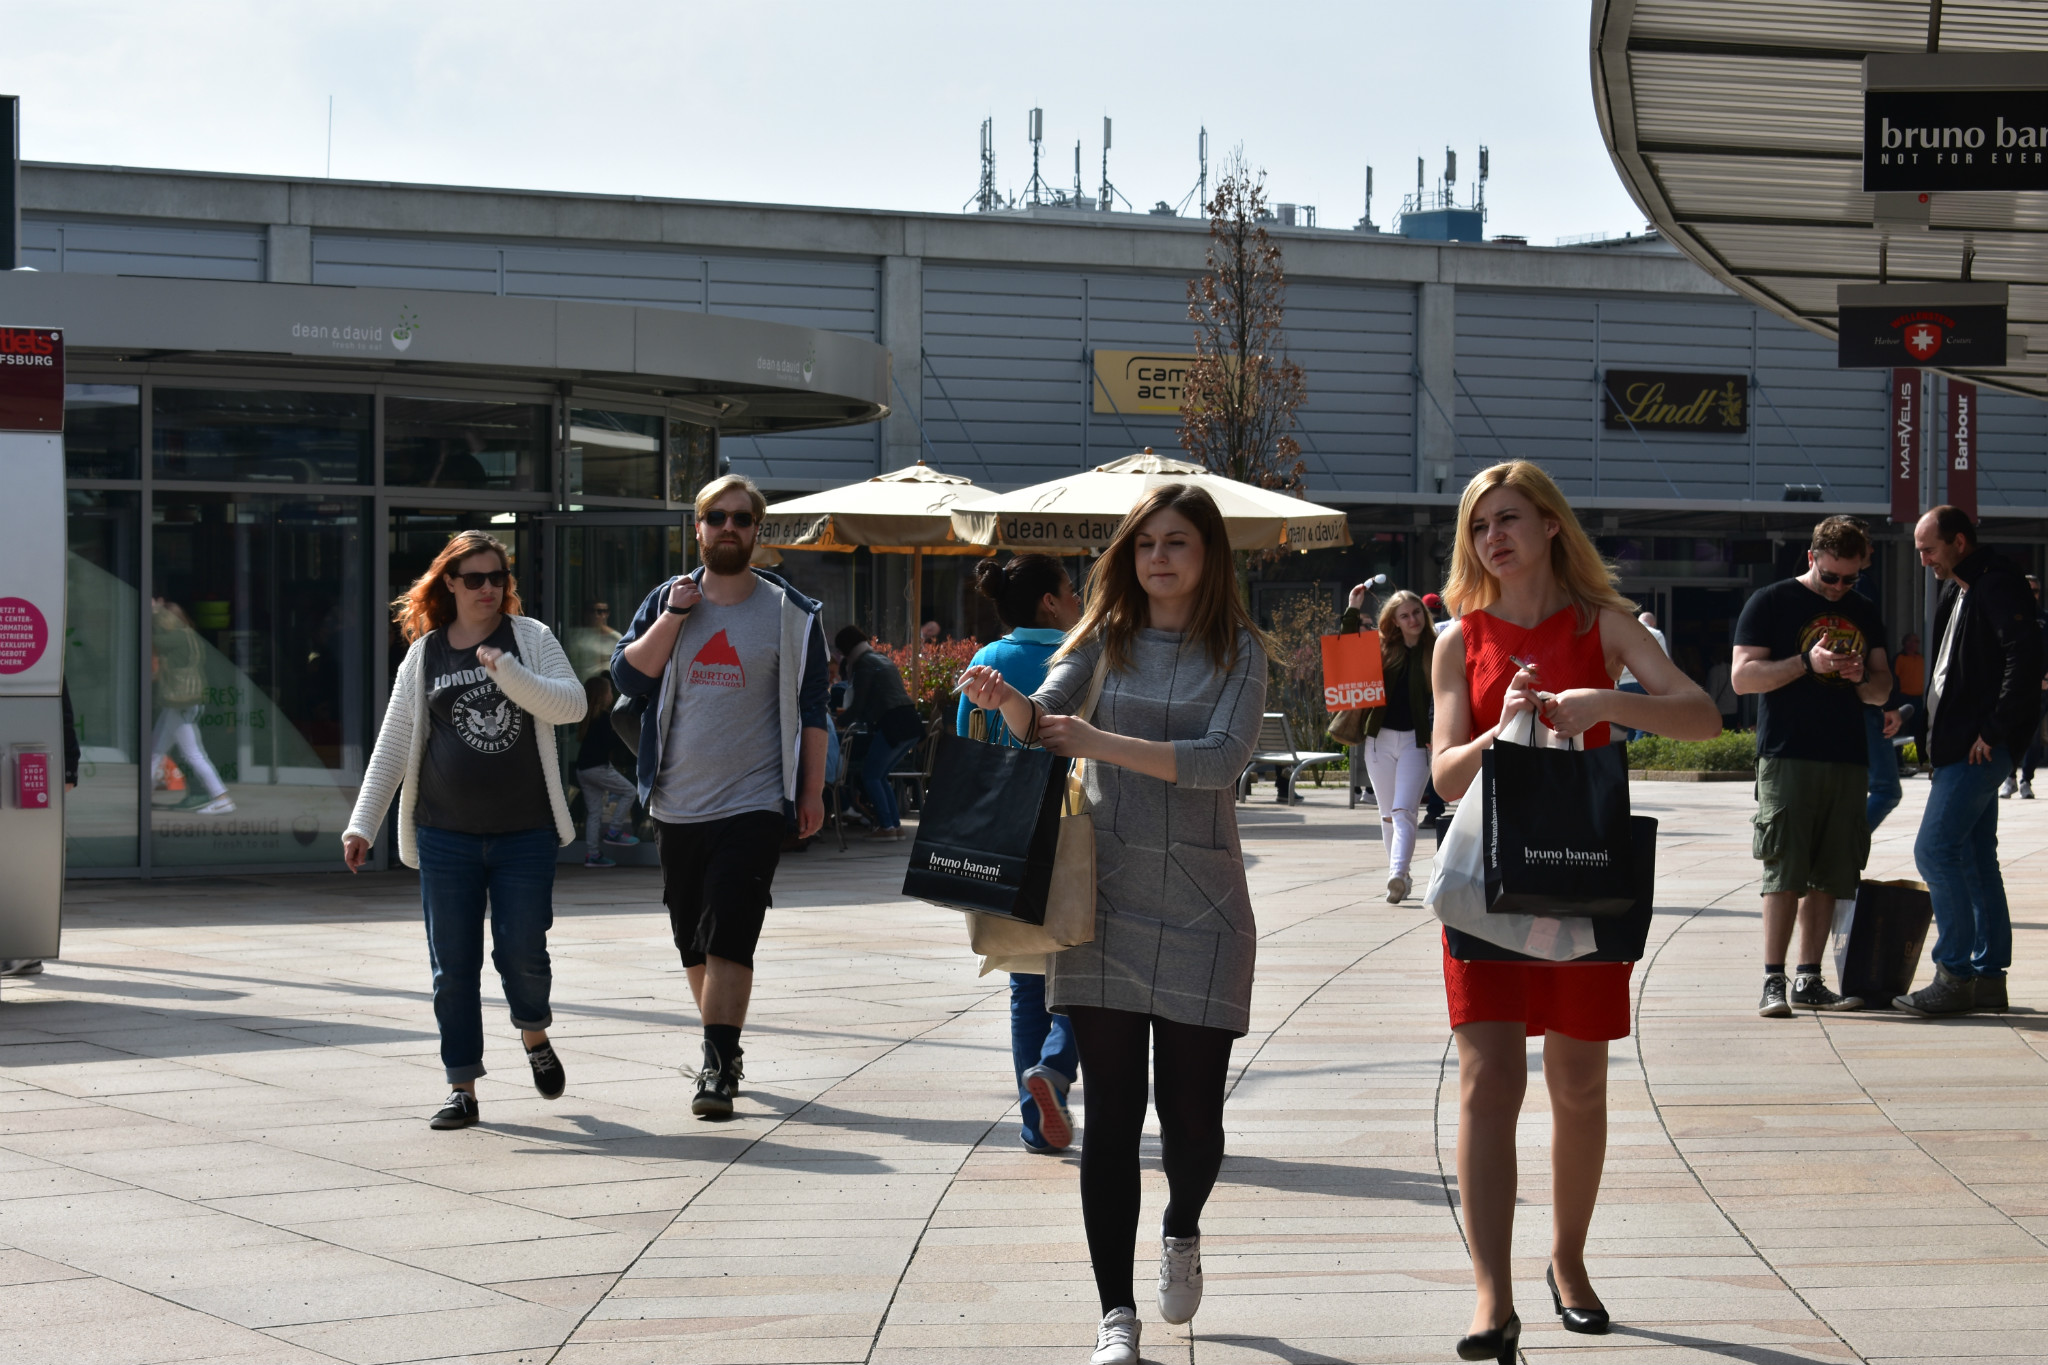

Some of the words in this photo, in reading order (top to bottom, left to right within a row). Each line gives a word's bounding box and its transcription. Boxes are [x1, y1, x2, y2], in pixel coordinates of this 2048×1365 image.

[1881, 117, 1986, 149] bruno
[1881, 153, 1919, 165] NOT
[1937, 153, 1973, 165] FOR
[1991, 152, 2042, 164] EVER
[292, 322, 328, 338] dean
[331, 327, 340, 340] &
[343, 325, 382, 341] david
[1138, 367, 1216, 384] cam
[1138, 385, 1215, 400] actie
[1614, 382, 1718, 425] Lindt
[1955, 394, 1968, 470] Barbour
[758, 522, 780, 538] ean
[783, 525, 791, 538] &
[1007, 519, 1057, 539] dean
[1063, 524, 1074, 539] &
[1079, 519, 1120, 540] dav
[434, 666, 487, 691] LONDO
[691, 670, 740, 681] BURTON
[462, 685, 492, 702] KINGS
[1324, 685, 1386, 708] Super
[159, 818, 207, 838] dean
[227, 817, 279, 836] david
[1524, 846, 1563, 859] bruno
[1565, 847, 1608, 861] banani
[929, 851, 961, 869] bruno
[963, 858, 1000, 877] banani
